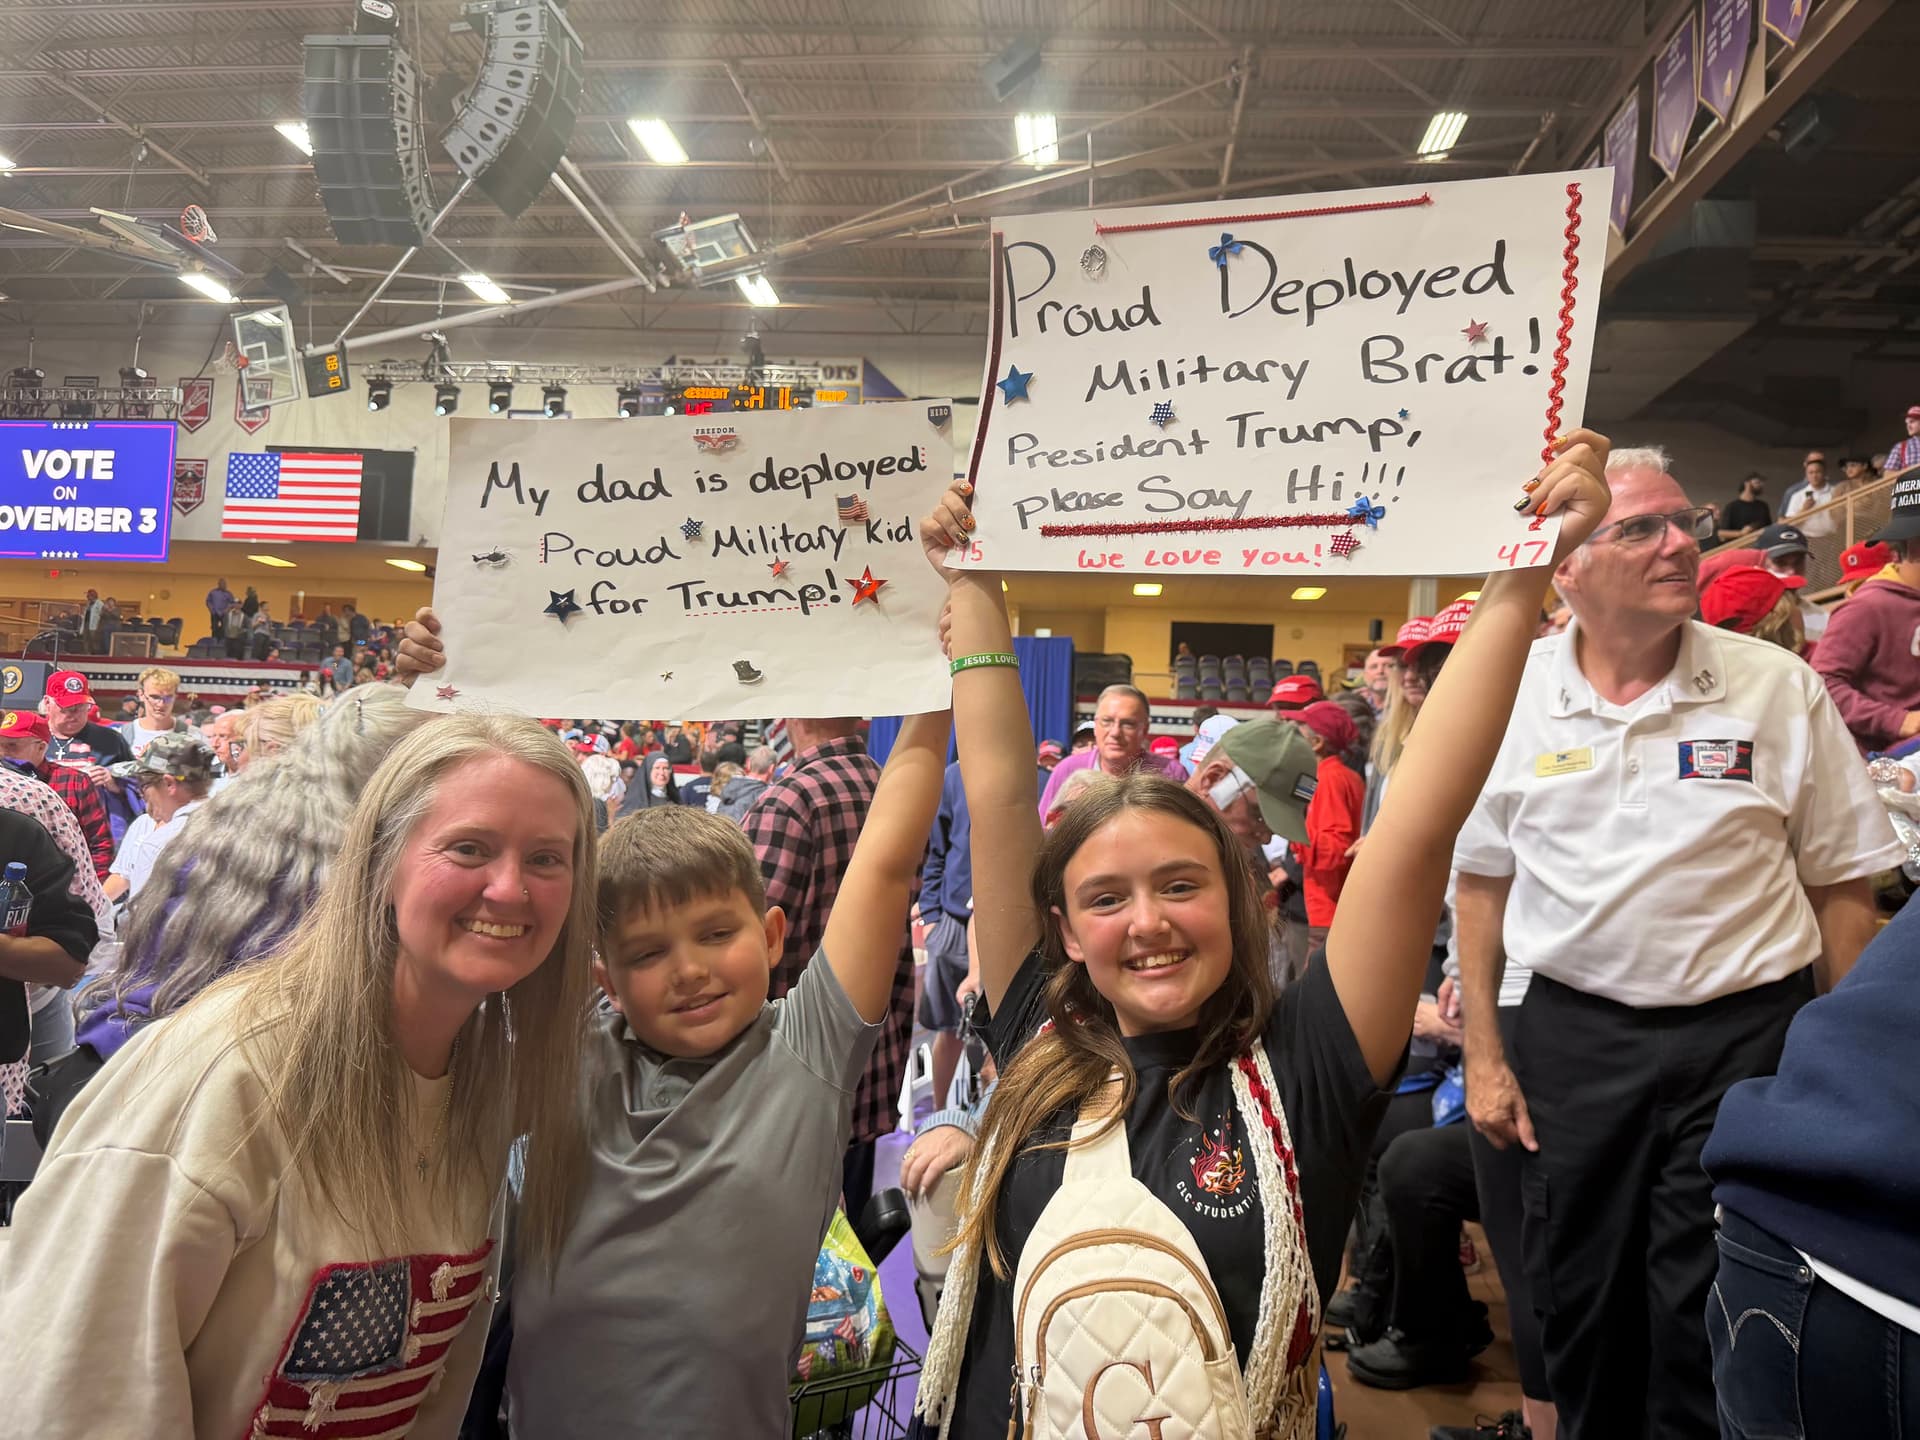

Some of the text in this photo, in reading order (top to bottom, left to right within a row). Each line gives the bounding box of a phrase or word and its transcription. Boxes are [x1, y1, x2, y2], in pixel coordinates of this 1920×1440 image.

[1003, 239, 1515, 338] Proud Deployed
[1084, 317, 1541, 402] Military Brat!
[695, 427, 735, 435] FREEDOM
[1008, 411, 1423, 469] President Trump,
[22, 449, 115, 480] VOTE
[480, 446, 927, 517] My dad is deployed
[53, 486, 77, 500] ON
[1137, 475, 1253, 519] Say
[1287, 462, 1406, 504] Hi!!!
[0, 505, 157, 533] OVEMBER 3
[543, 532, 682, 567] Proud
[712, 522, 847, 562] Military
[1242, 544, 1322, 567] you!
[1497, 540, 1549, 567] 47
[585, 568, 841, 616] for Trump!
[963, 655, 992, 666] JESUS
[4, 908, 29, 929] FIJI
[1082, 1360, 1172, 1440] G
